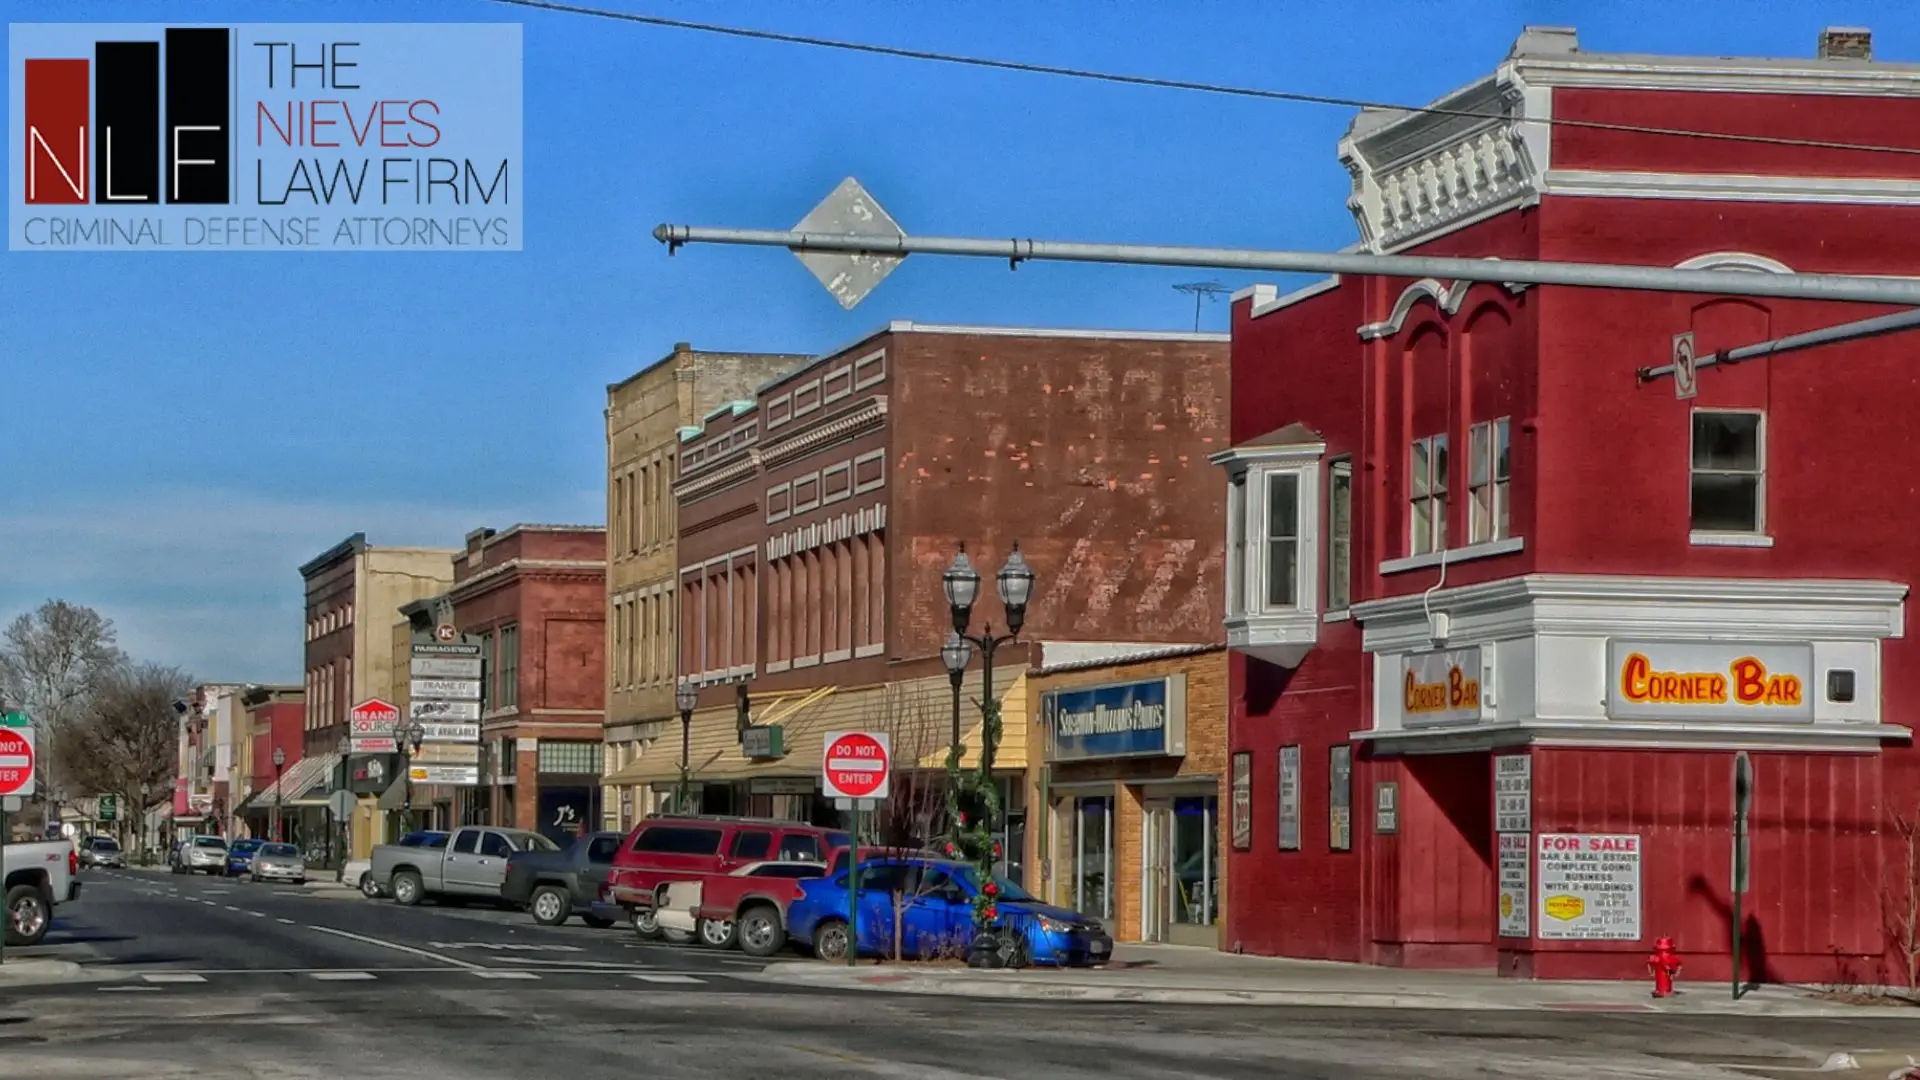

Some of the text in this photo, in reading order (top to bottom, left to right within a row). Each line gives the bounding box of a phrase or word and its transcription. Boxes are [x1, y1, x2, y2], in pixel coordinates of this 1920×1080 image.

[1621, 651, 1803, 706] CORNER BAR
[1404, 664, 1479, 714] CORNER BAR
[354, 710, 397, 721] BRAND
[0, 741, 24, 753] NOT
[836, 744, 877, 757] DO NOT
[0, 770, 19, 782] TER
[838, 773, 874, 785] ENTER
[1543, 838, 1637, 851] FOR SALE
[1540, 853, 1561, 861] BAR
[1575, 853, 1600, 861] REAL
[1603, 853, 1639, 862] ESTATE
[1546, 863, 1632, 872] COMPLETE GOING
[1565, 873, 1613, 881] BUSINESS
[1545, 882, 1634, 892] WITH 2-BUILDINGS
